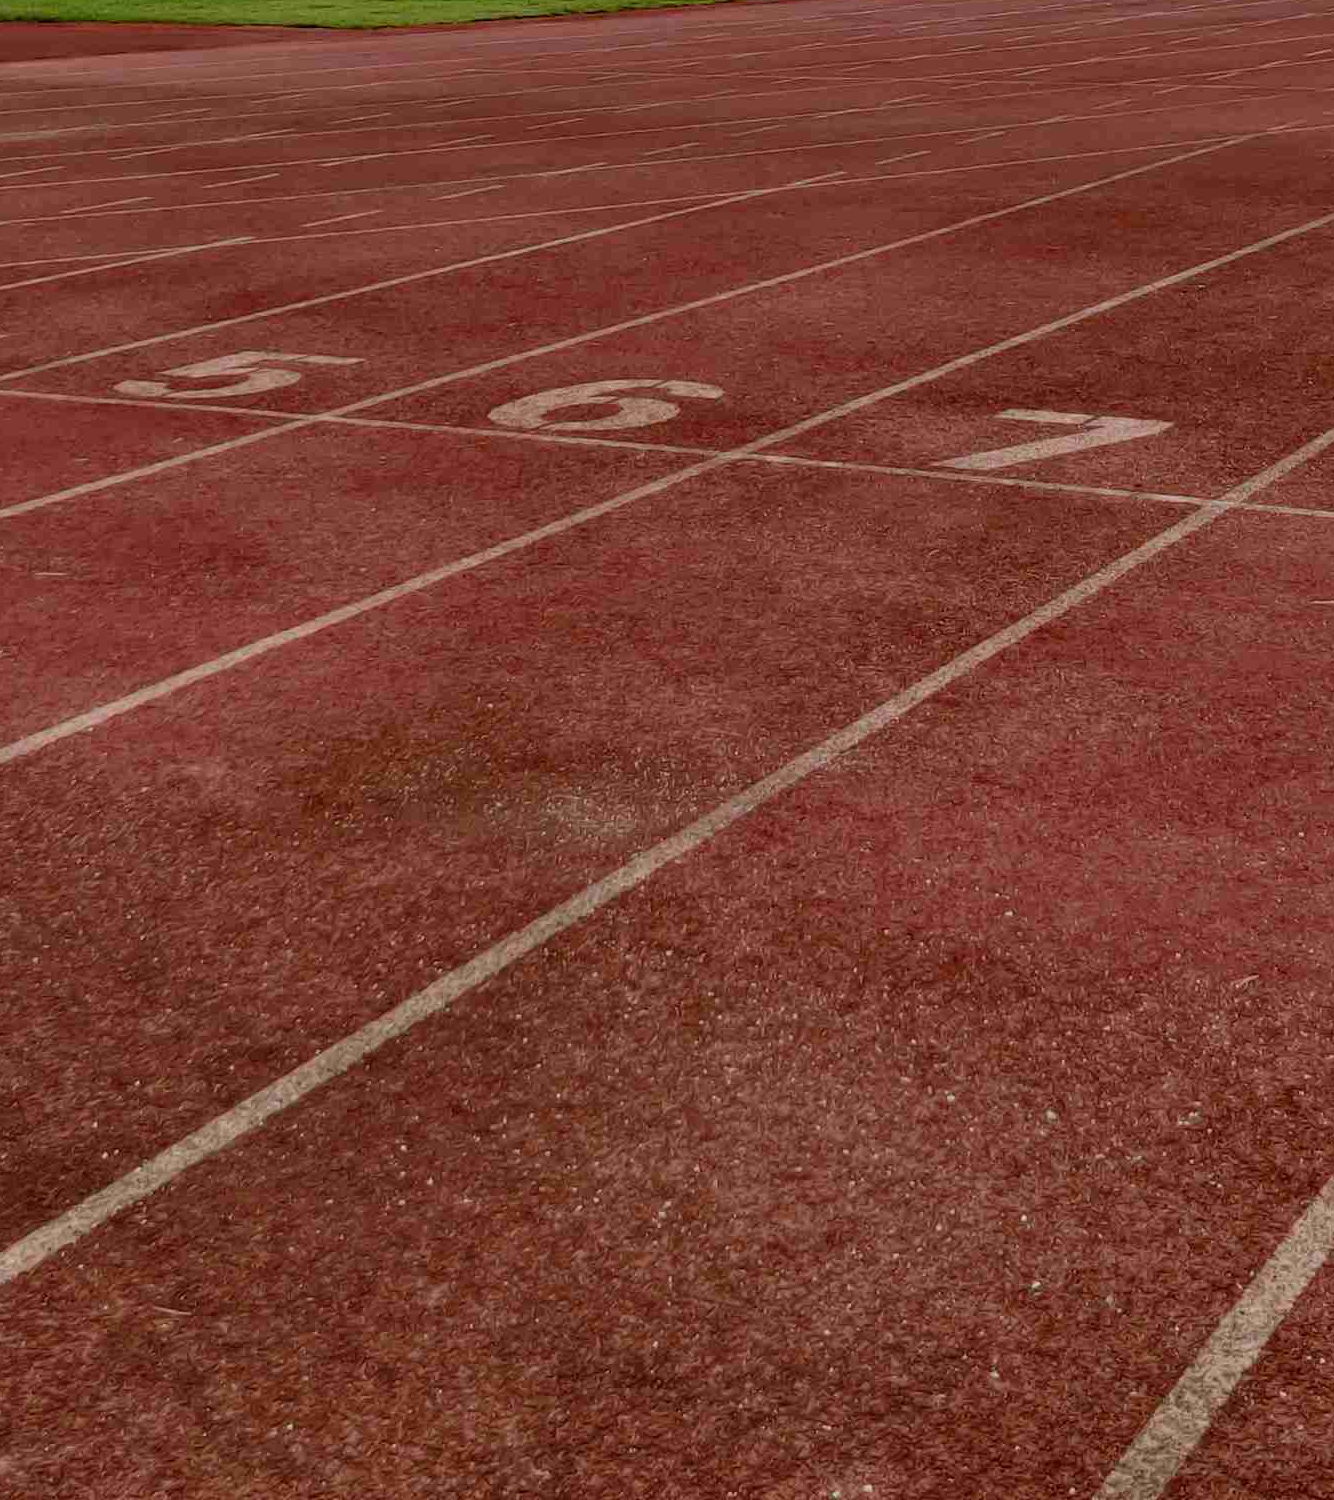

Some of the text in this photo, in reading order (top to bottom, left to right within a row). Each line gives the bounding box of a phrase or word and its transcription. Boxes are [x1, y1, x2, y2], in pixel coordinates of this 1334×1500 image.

[114, 351, 366, 399] 5
[488, 379, 724, 431] 6
[933, 409, 1174, 470] 7
